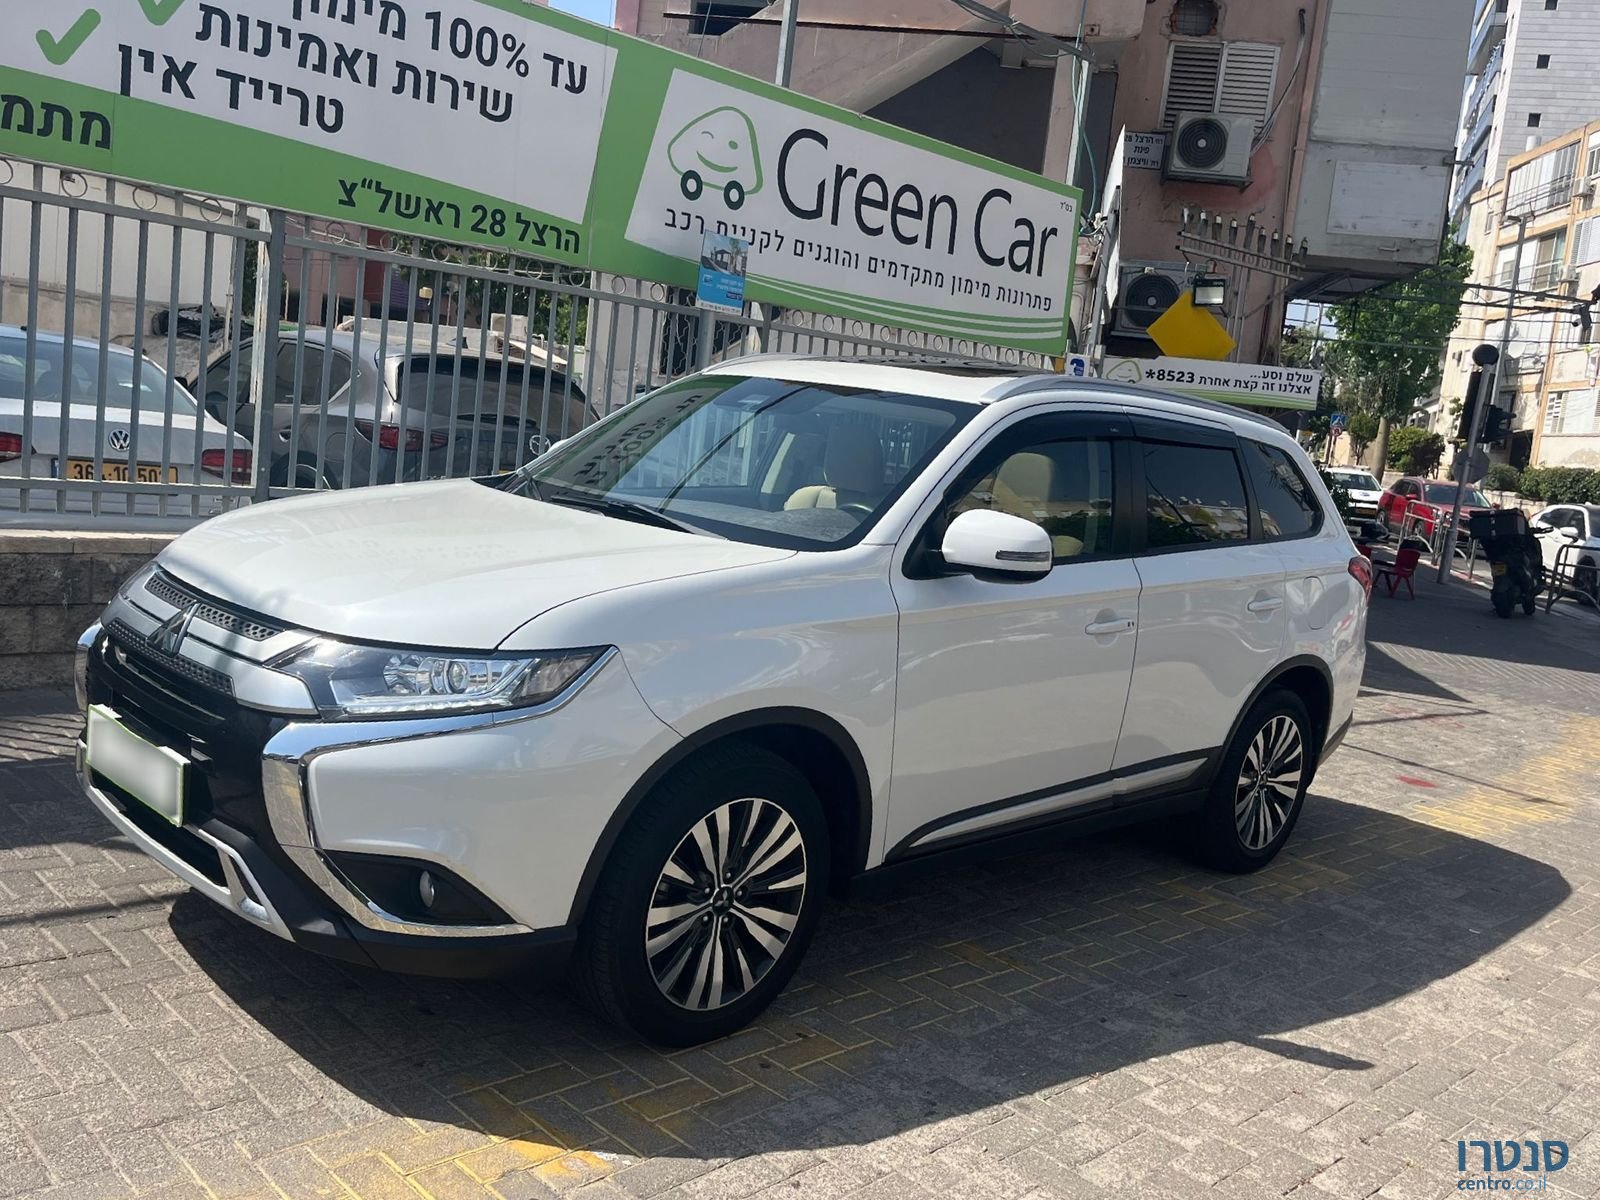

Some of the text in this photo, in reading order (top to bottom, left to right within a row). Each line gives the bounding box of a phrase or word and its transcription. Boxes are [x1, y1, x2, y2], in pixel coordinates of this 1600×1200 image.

[196, 3, 512, 122] שירות ואמינות
[425, 12, 529, 78] 100%
[119, 44, 344, 133] טרייד אין
[543, 53, 588, 94] עד
[1133, 146, 1150, 154] פינת
[1135, 134, 1154, 144] הרצל
[470, 205, 507, 237] 28
[777, 129, 1058, 278] Green Car
[516, 212, 580, 254] הרצל
[665, 208, 1052, 311] פתרונות מימון מתקדמים והוגנים לקניית רכב
[1198, 376, 1312, 394] אצלנו זה קצת אחרת
[1286, 372, 1313, 383] שלם
